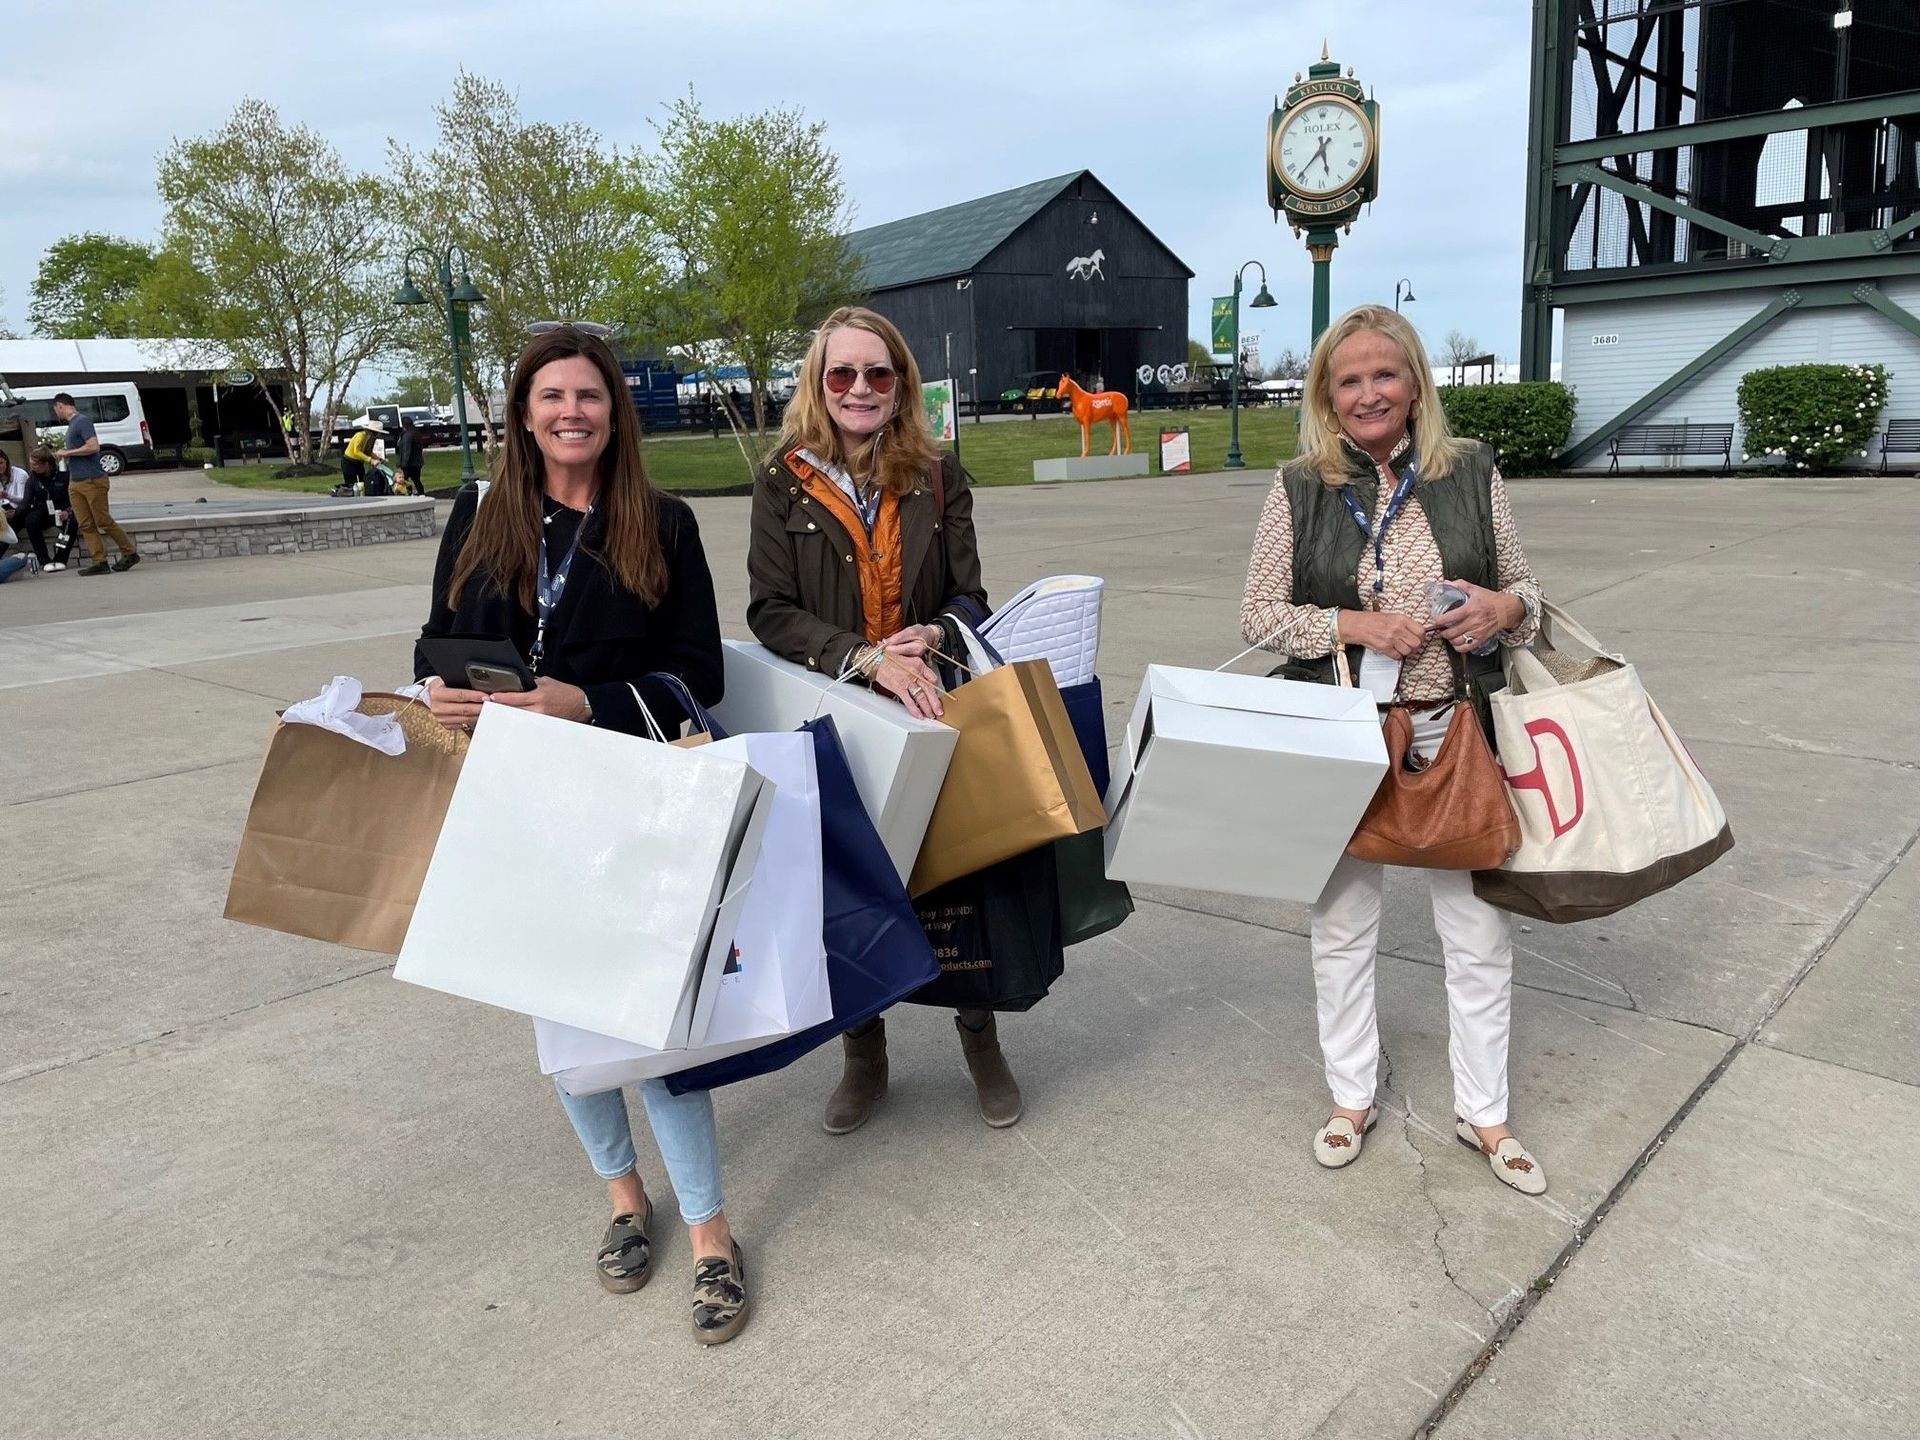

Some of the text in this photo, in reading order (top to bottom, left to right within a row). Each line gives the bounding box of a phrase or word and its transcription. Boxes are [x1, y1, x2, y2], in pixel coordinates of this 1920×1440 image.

[1300, 82, 1346, 97] KENTUCKY
[1304, 123, 1341, 133] ROLEX
[1296, 199, 1348, 211] HORSE PARK
[1241, 335, 1260, 344] BEST
[1593, 335, 1618, 345] 3680
[942, 905, 973, 917] OUND!
[940, 959, 993, 970] oducts.com
